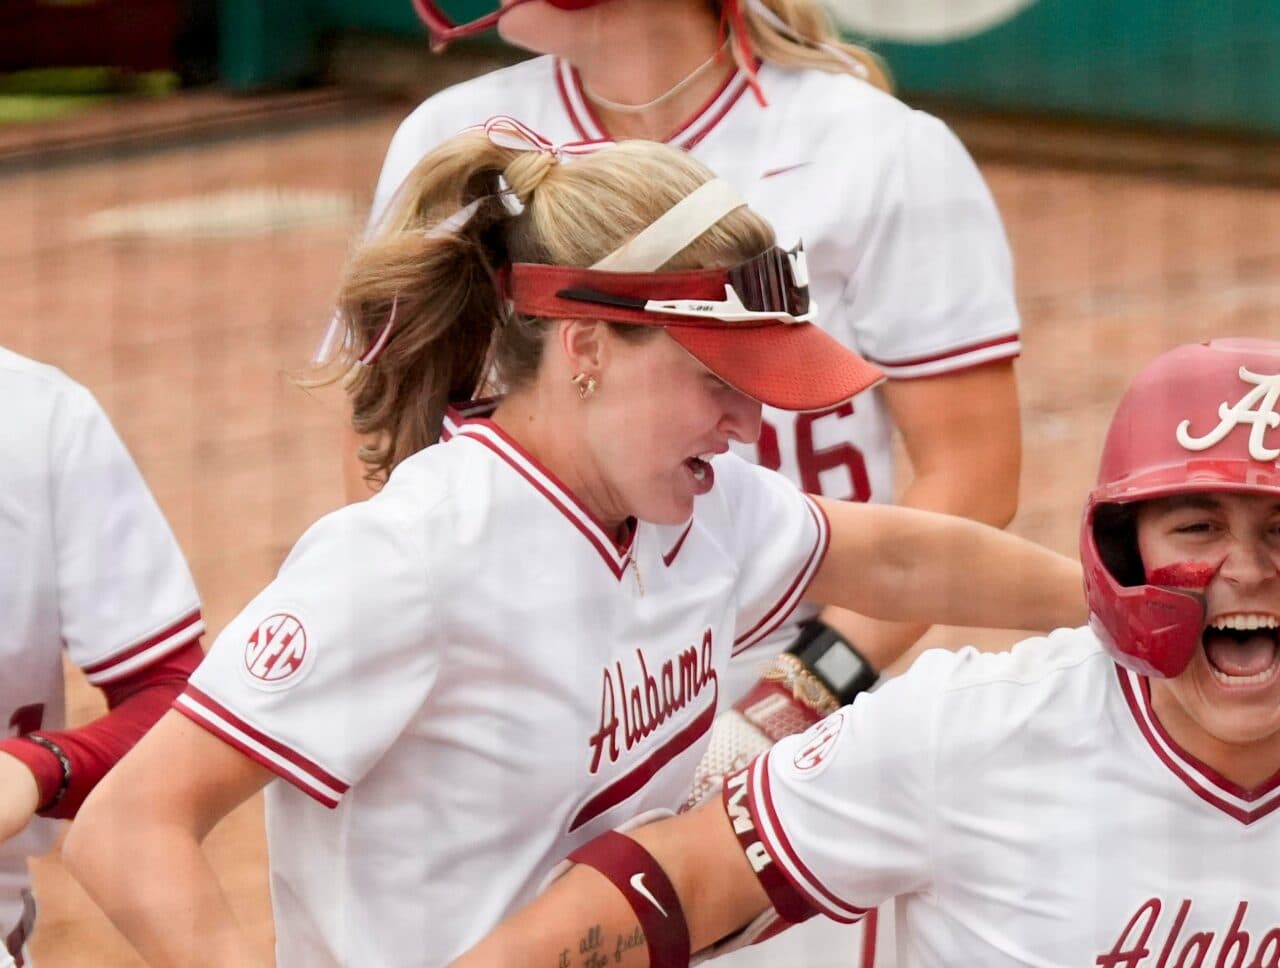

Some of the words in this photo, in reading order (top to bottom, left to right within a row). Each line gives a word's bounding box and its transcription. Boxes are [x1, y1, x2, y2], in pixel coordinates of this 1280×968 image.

[758, 400, 872, 503] 6
[244, 613, 307, 681] SEC
[588, 628, 717, 774] Alabama
[579, 924, 603, 954] all
